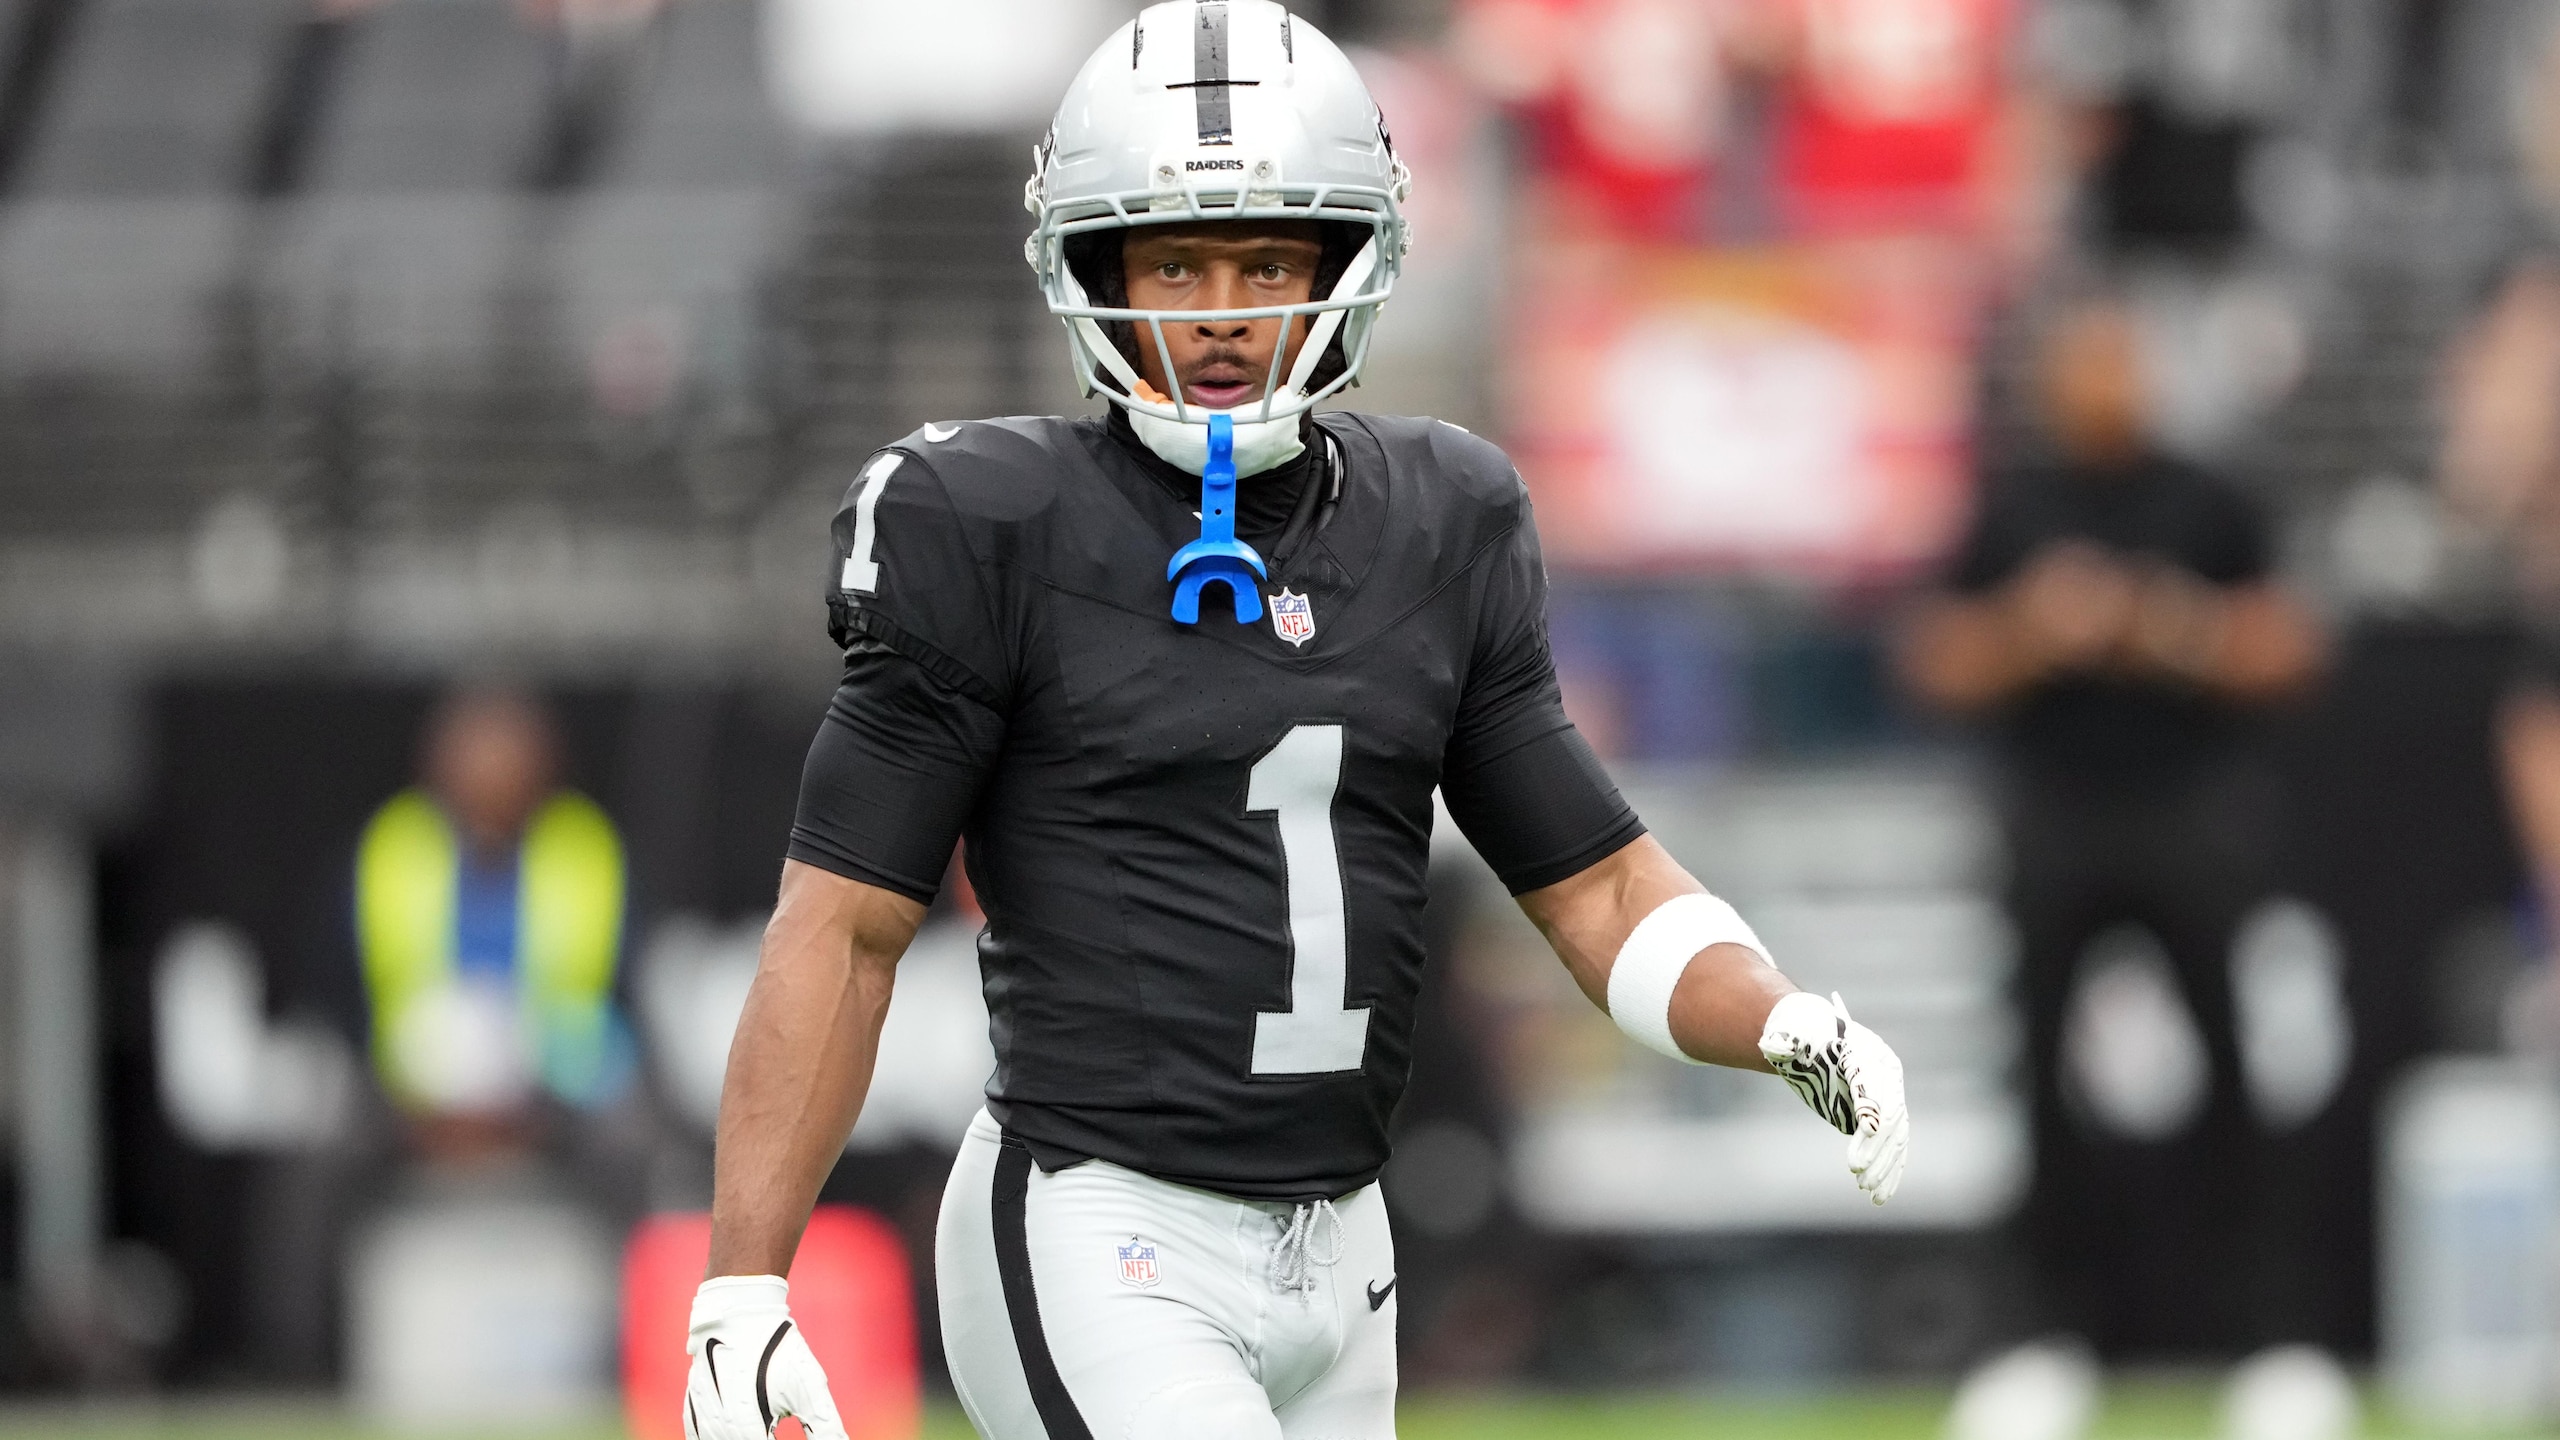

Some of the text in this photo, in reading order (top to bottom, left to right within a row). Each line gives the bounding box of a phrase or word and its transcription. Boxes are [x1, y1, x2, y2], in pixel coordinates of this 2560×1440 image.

[1185, 159, 1244, 172] RAIDERS
[841, 453, 905, 593] 1
[1280, 614, 1310, 636] NFL
[1246, 724, 1372, 1075] 1
[1123, 1260, 1156, 1280] NFL
